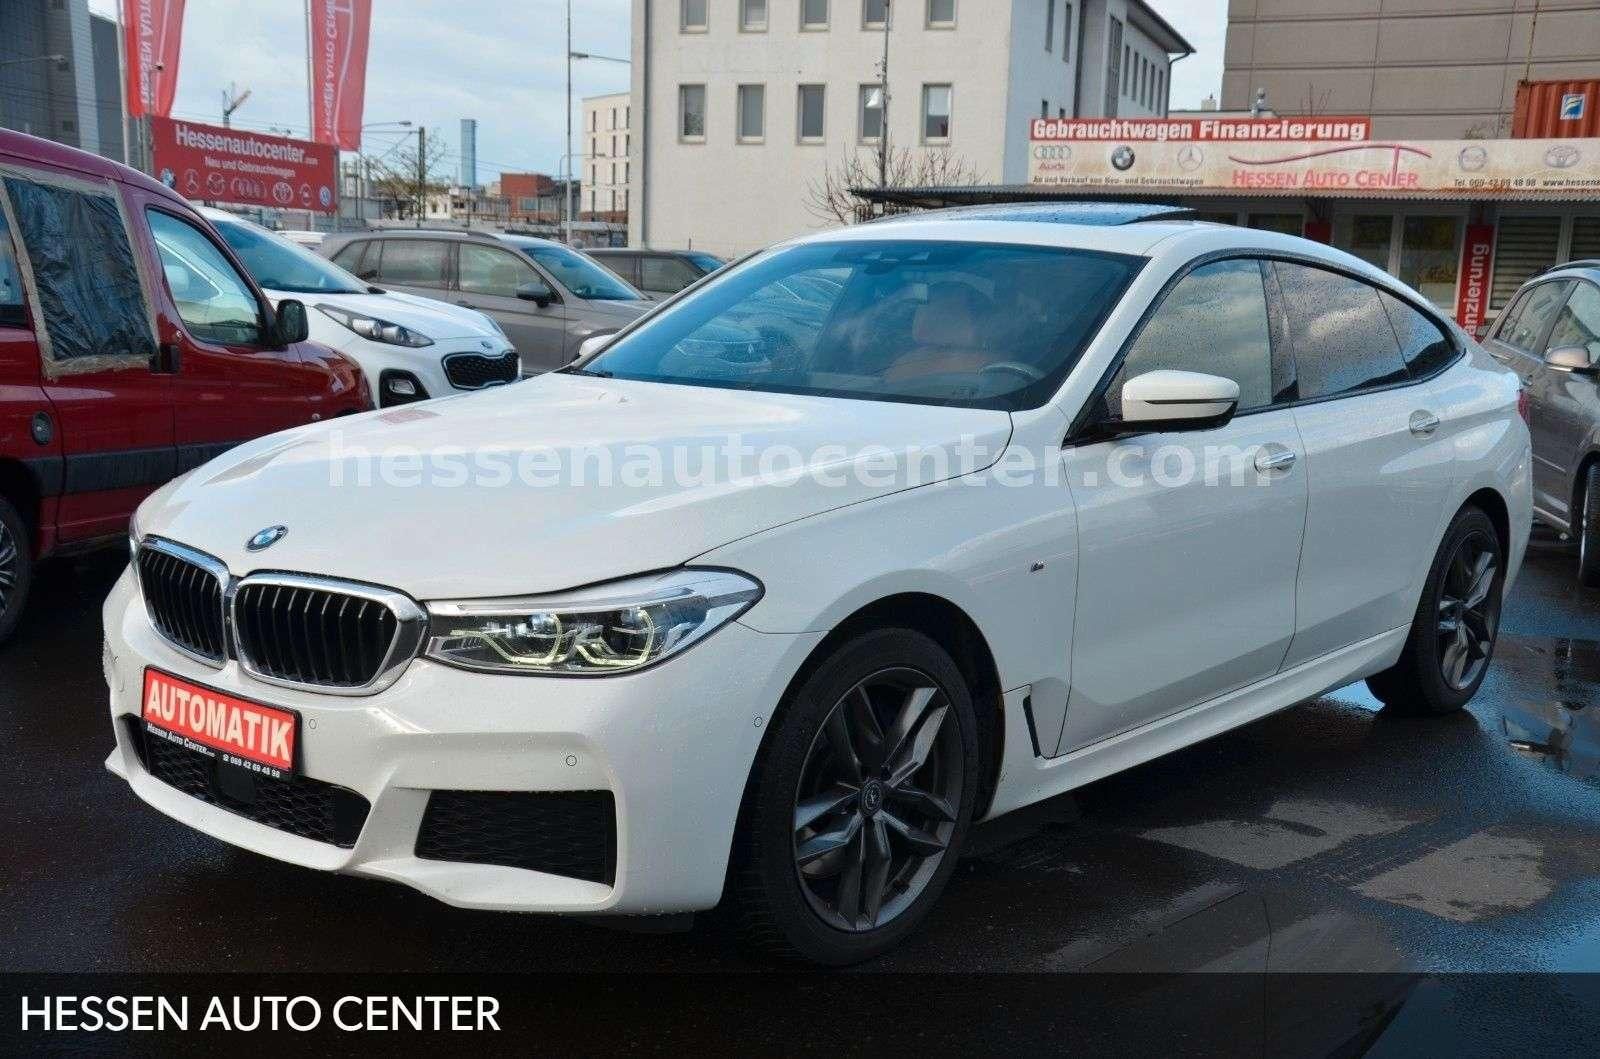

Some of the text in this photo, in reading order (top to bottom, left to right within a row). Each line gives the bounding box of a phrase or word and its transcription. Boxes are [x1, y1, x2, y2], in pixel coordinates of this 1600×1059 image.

[1033, 120, 1366, 141] Gebrauchtwagen Finanzierung
[1232, 169, 1420, 188] HESSEN AUTO CENTER
[1463, 243, 1489, 336] anzierung
[147, 680, 293, 762] AUTOMATIK
